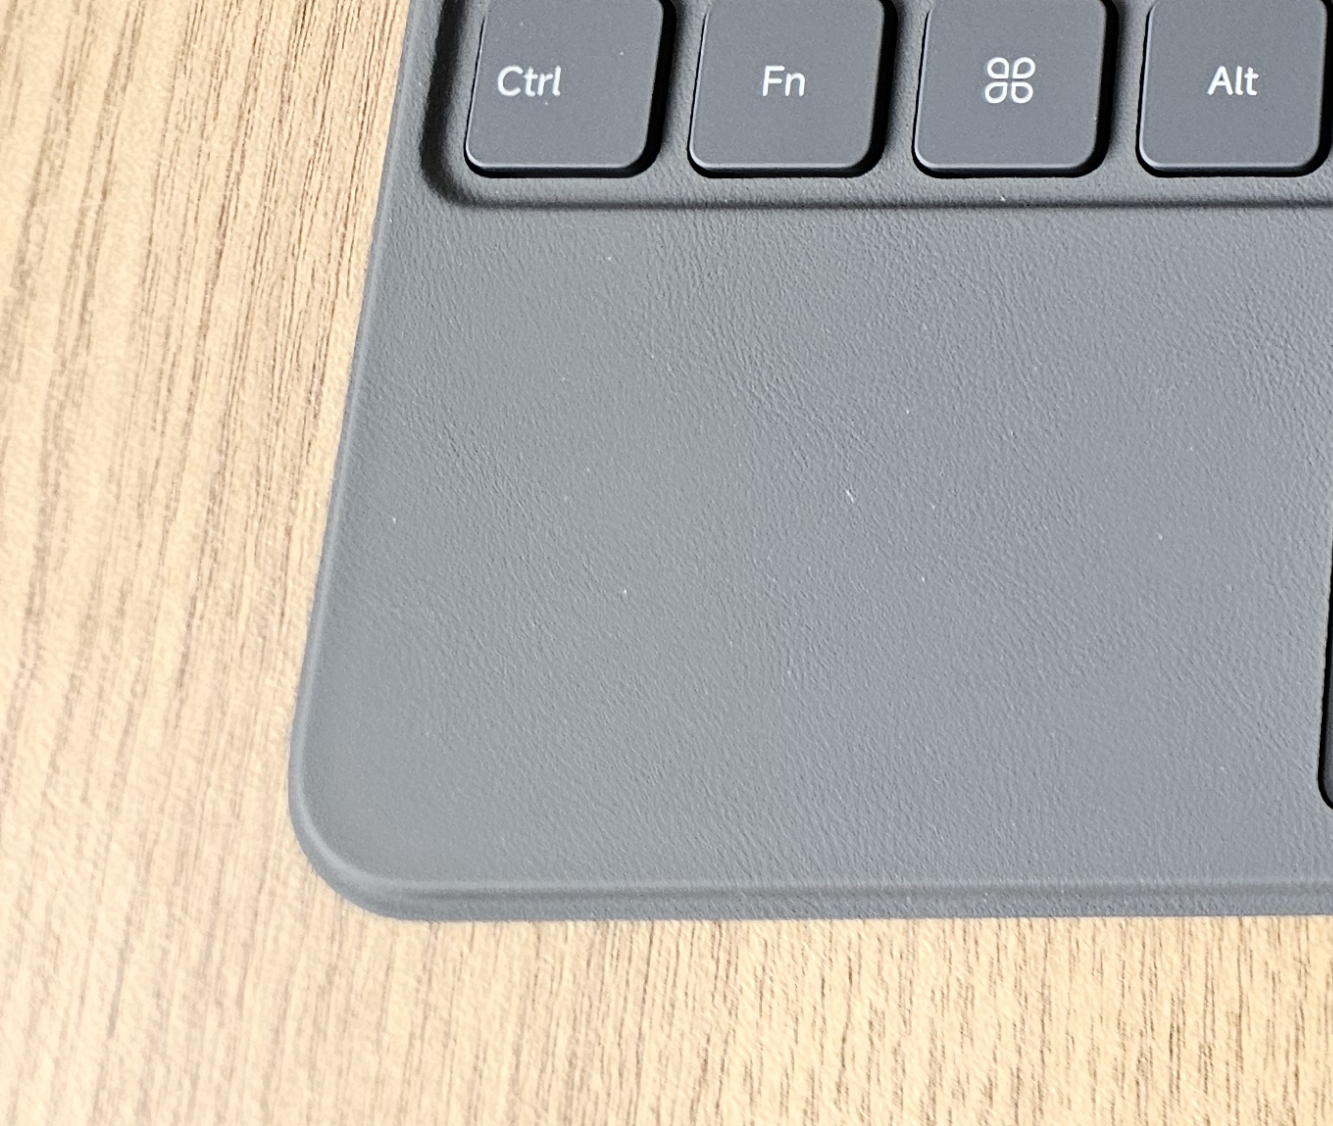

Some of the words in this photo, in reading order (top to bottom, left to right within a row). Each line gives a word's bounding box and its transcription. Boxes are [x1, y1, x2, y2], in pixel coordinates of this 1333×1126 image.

[497, 65, 562, 97] Ctrl
[762, 65, 806, 97] Fn
[1206, 65, 1259, 96] Alt
